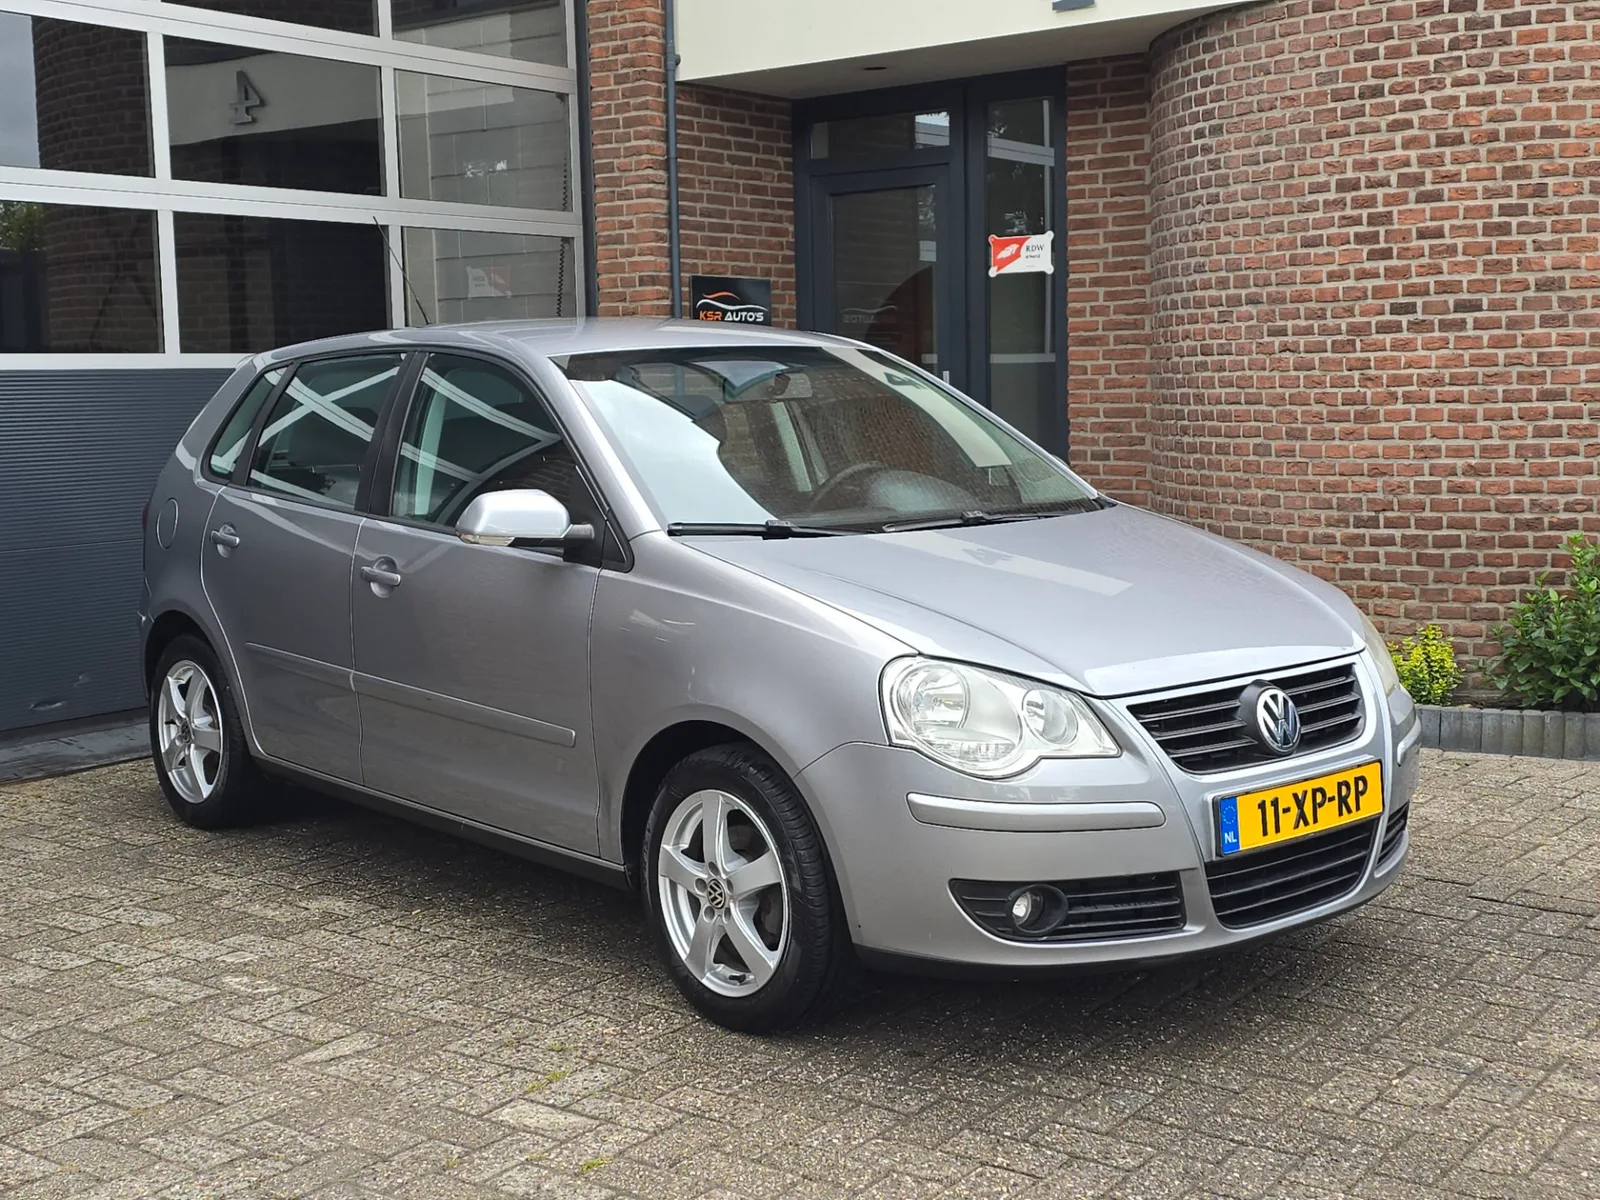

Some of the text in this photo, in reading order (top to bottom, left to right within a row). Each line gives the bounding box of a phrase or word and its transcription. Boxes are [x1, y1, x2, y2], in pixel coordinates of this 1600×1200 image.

[1025, 243, 1045, 253] RDW
[699, 310, 764, 322] KSR AUTO'S
[1257, 775, 1368, 837] 11-XP-RP
[1224, 831, 1237, 844] NL
